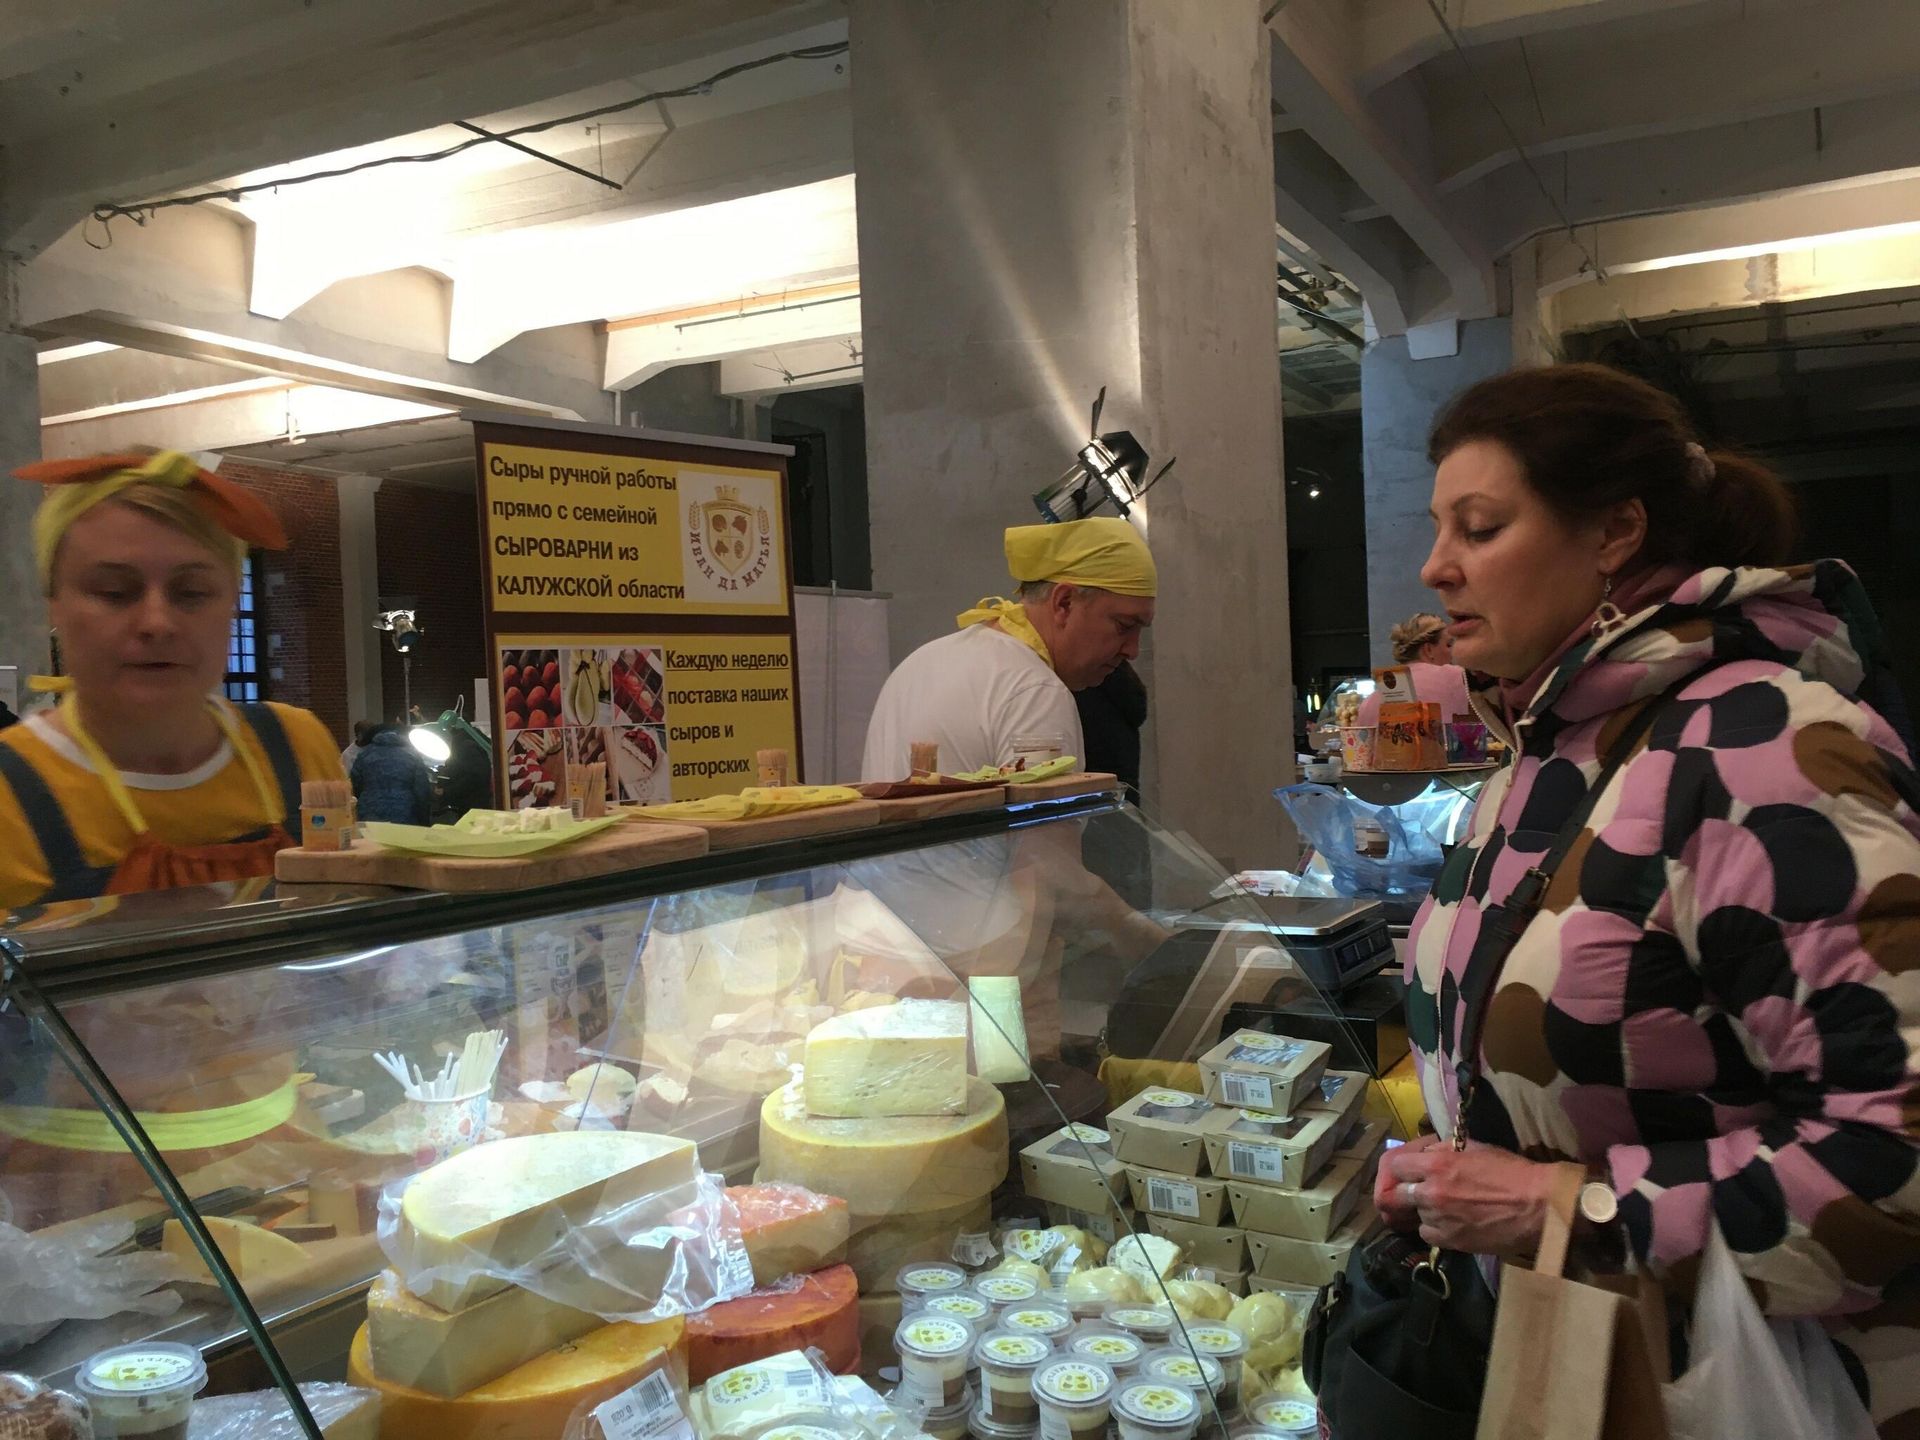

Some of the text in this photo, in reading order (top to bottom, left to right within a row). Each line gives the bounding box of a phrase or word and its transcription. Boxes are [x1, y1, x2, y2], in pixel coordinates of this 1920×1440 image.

[490, 456, 677, 490] Сыры ручной работы
[493, 500, 657, 525] прямо с семейной
[495, 535, 639, 561] СЫРОВАРНИ из
[690, 531, 771, 591] ИВАН ДА МАРЬЯ
[497, 575, 685, 599] КАЛУЖСКОЙ области
[666, 650, 789, 672] Каждую неделю
[668, 688, 789, 704] поставка наших
[670, 725, 734, 744] сыров и
[672, 759, 750, 779] авторских
